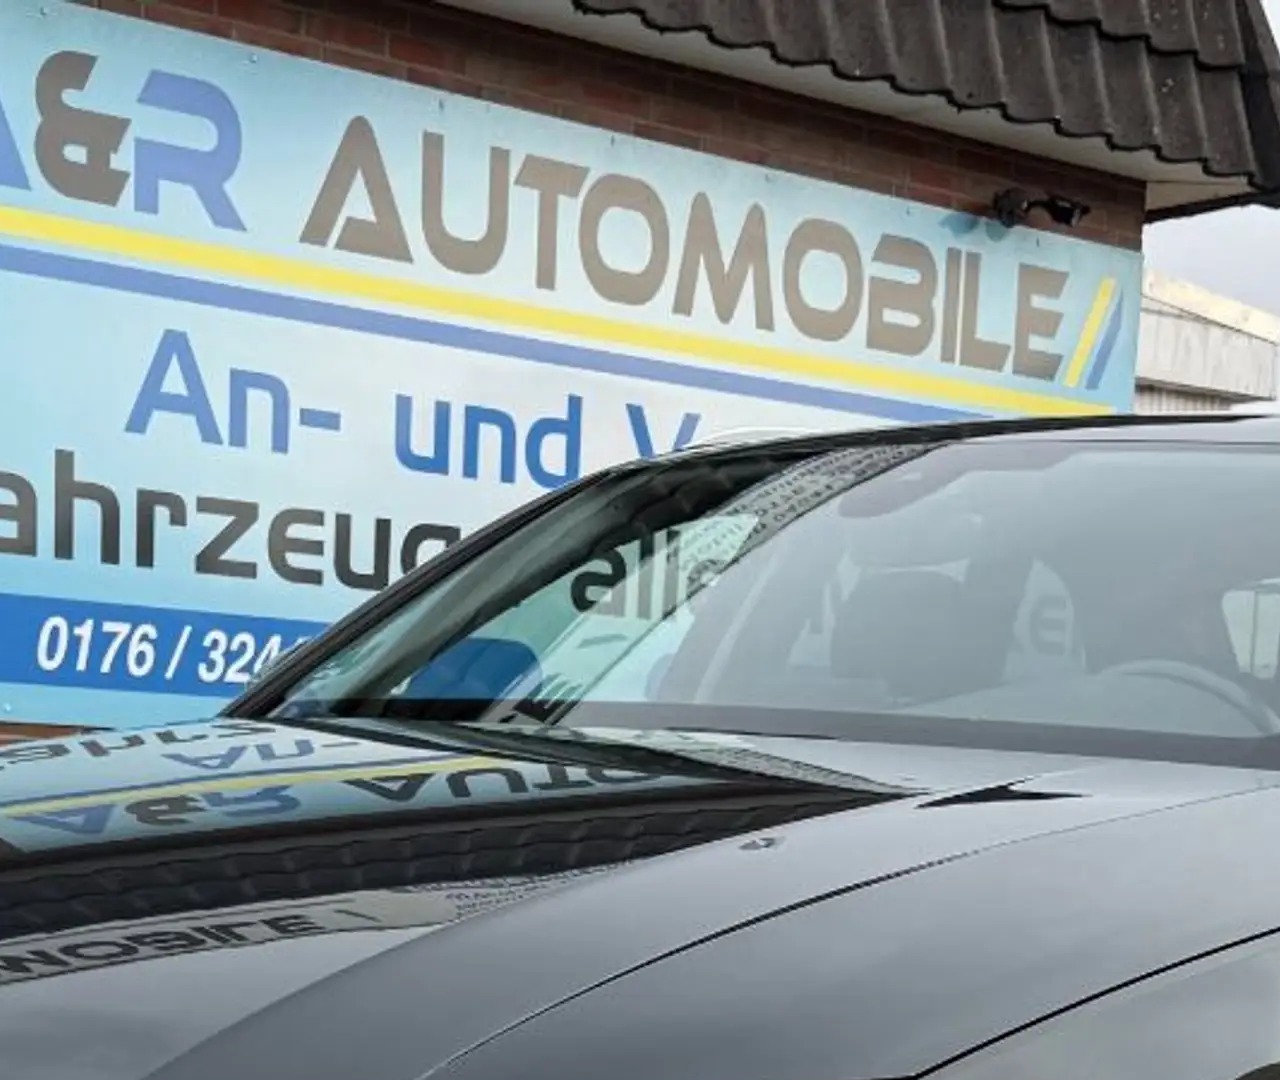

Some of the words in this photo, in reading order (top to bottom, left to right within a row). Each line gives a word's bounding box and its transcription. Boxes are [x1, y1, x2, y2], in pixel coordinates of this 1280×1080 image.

[299, 115, 1070, 382] AUTOMOBILE
[124, 328, 342, 455] An-
[394, 392, 582, 489] und
[627, 402, 701, 461] V
[36, 614, 158, 677] 0176
